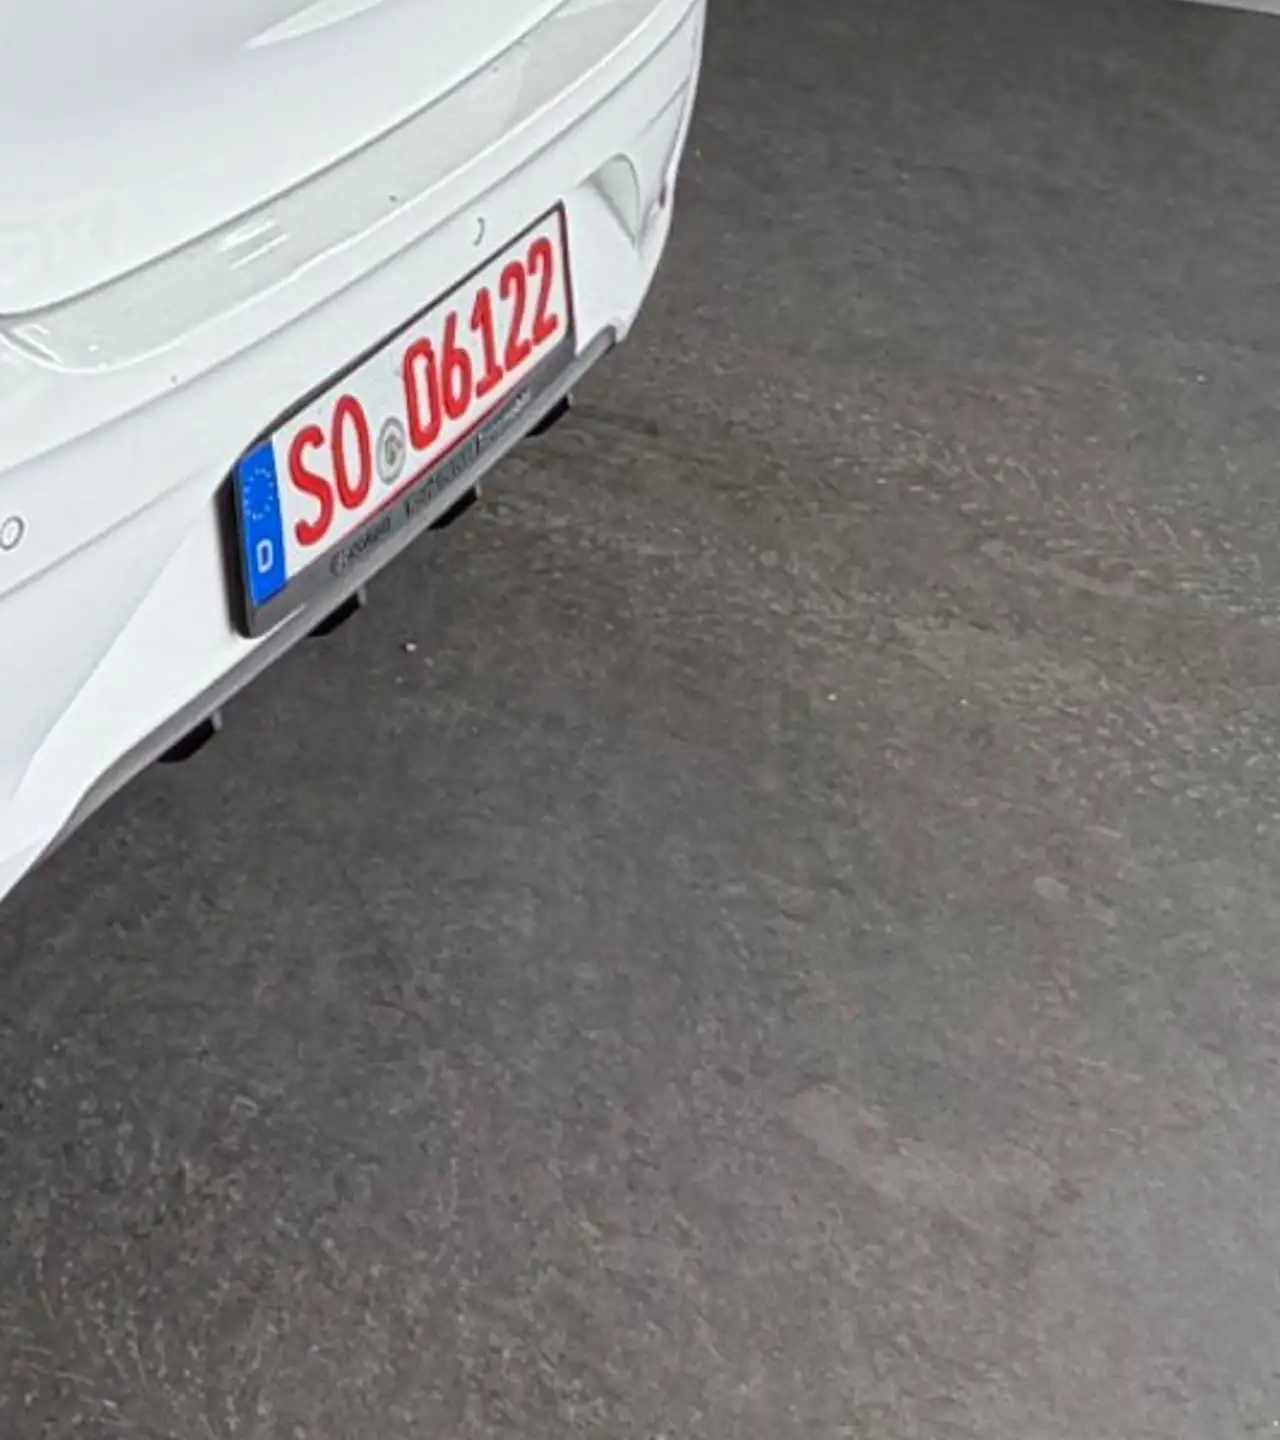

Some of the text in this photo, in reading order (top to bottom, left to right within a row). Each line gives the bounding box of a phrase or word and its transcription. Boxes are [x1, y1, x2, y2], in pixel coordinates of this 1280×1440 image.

[256, 538, 274, 574] D
[288, 394, 371, 547] SO
[402, 236, 560, 452] 06122
